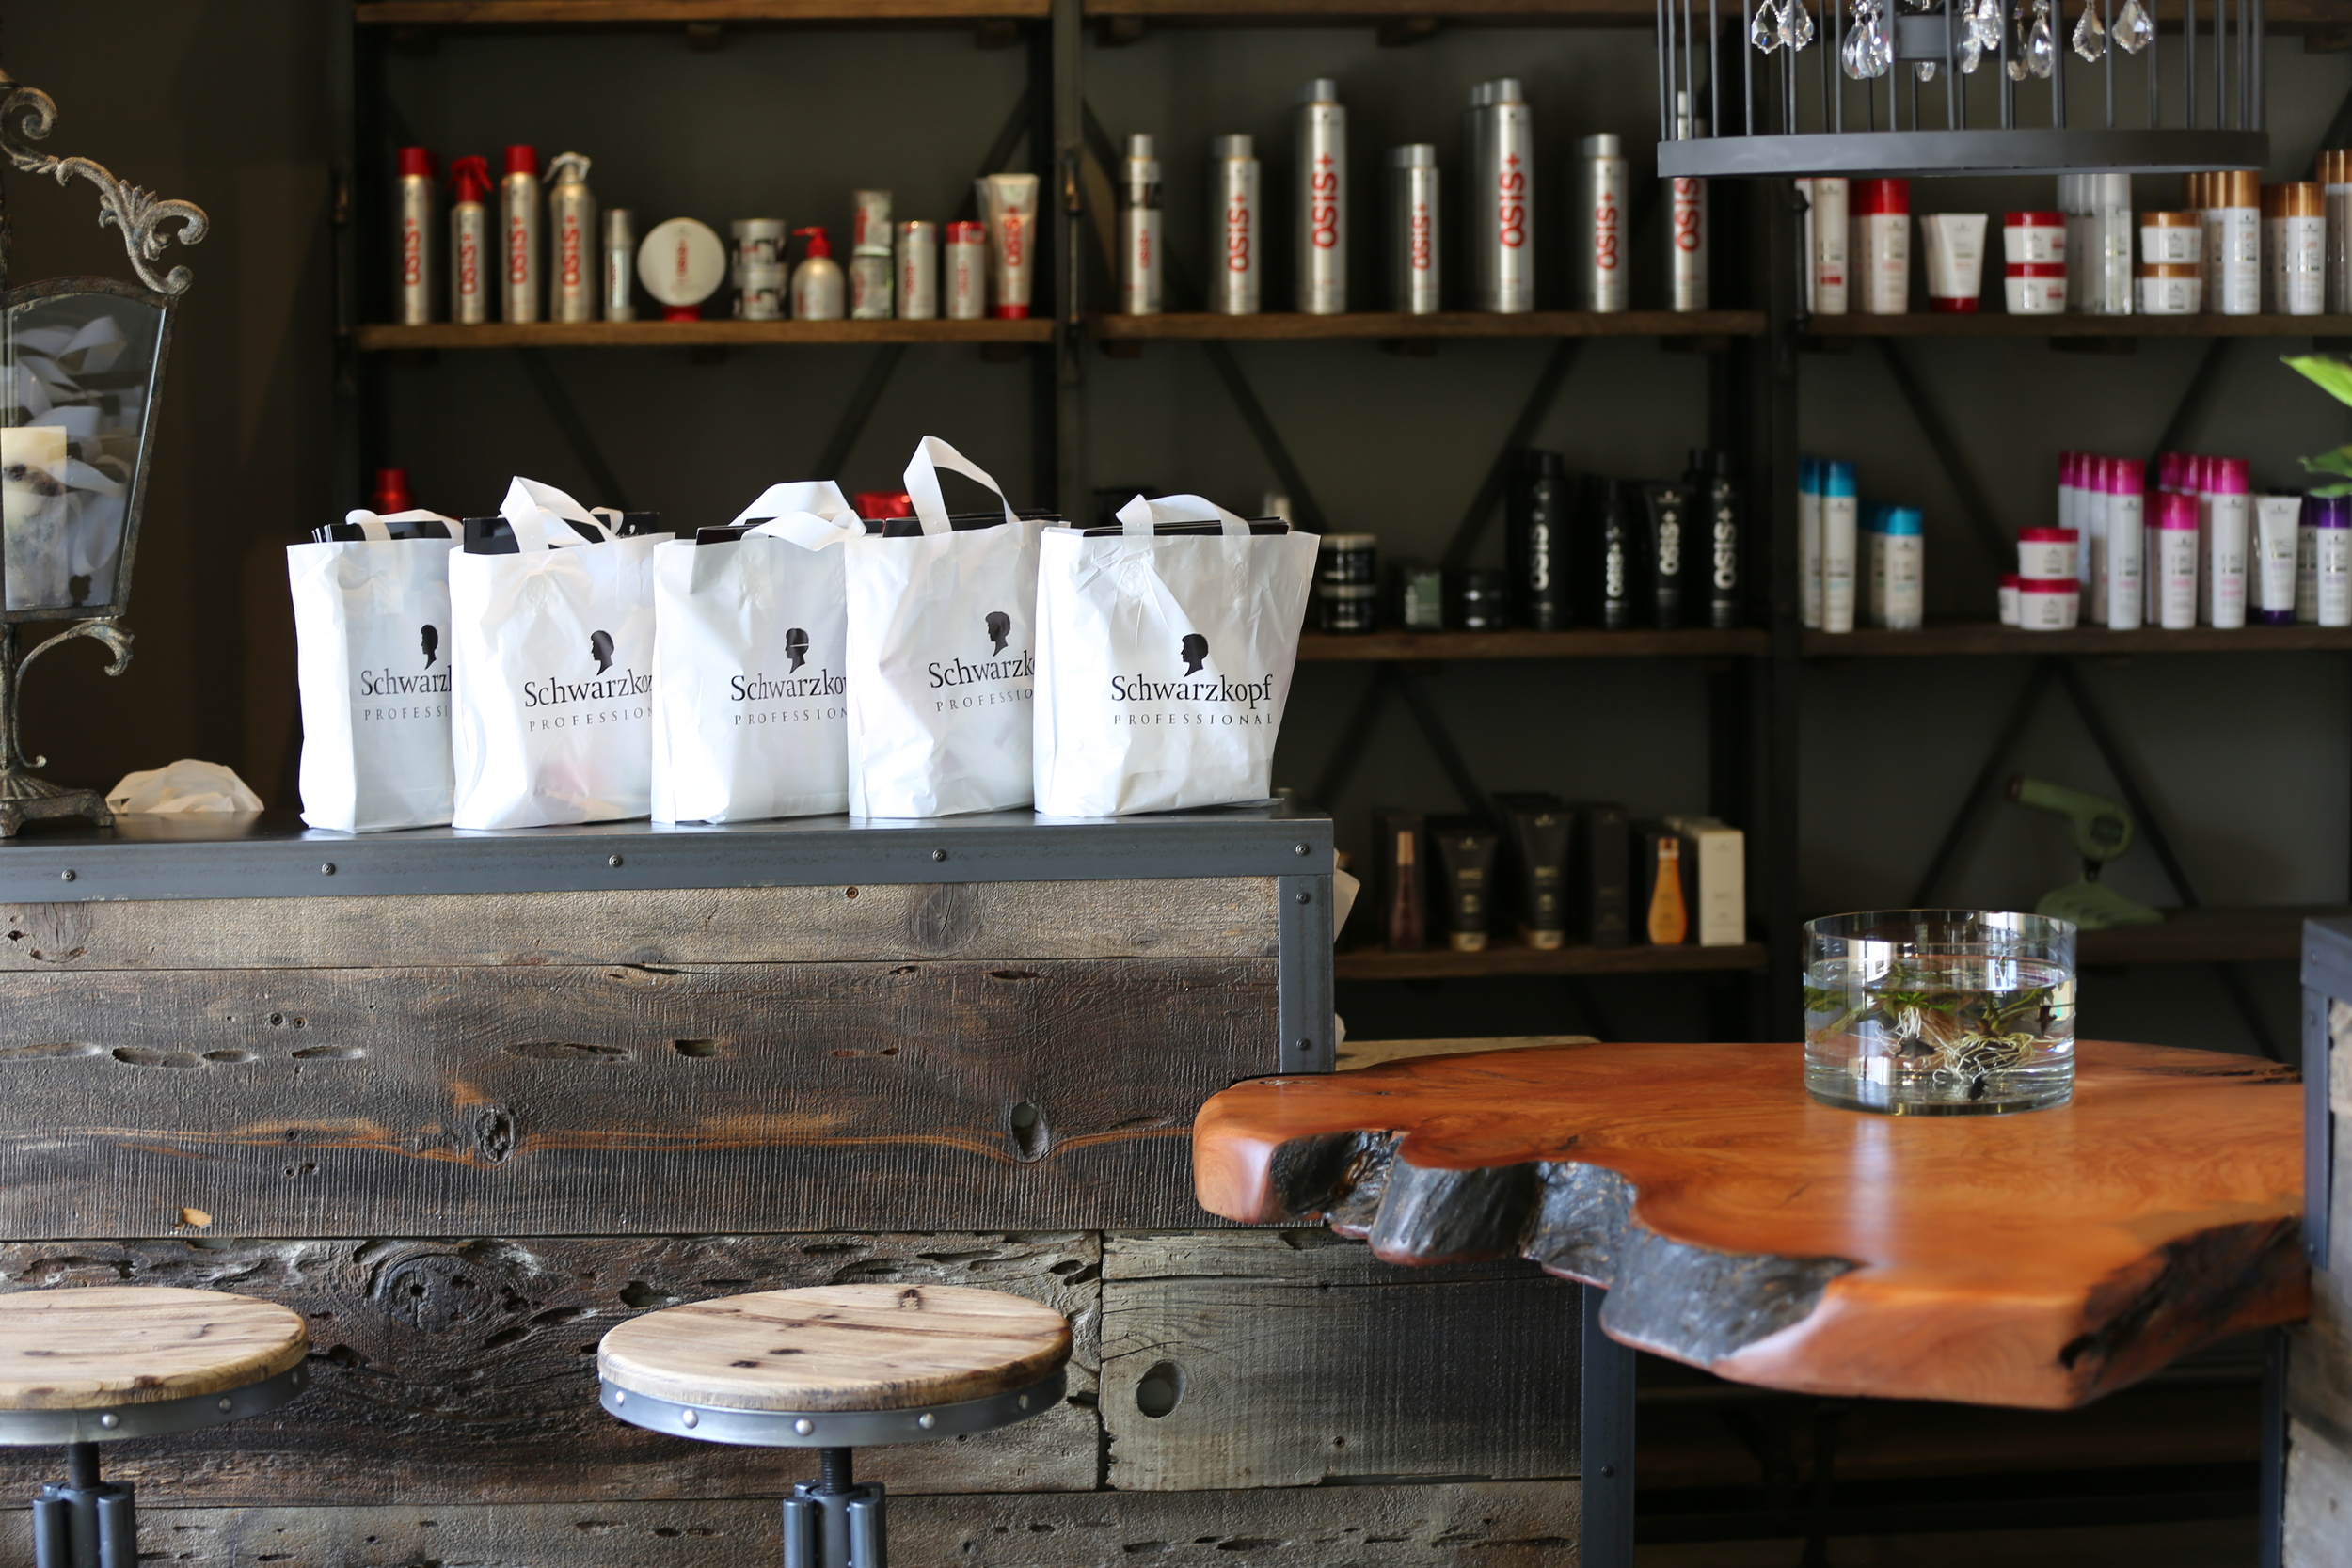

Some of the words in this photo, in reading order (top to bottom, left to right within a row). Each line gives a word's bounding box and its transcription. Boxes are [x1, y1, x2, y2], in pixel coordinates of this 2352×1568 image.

[927, 649, 1034, 689] Schwarzk
[936, 688, 1033, 713] PROFESSIO
[1111, 673, 1273, 710] Schwarzkopf
[363, 705, 448, 721] PROFESSI
[1114, 713, 1273, 726] PROFESSIONAL
